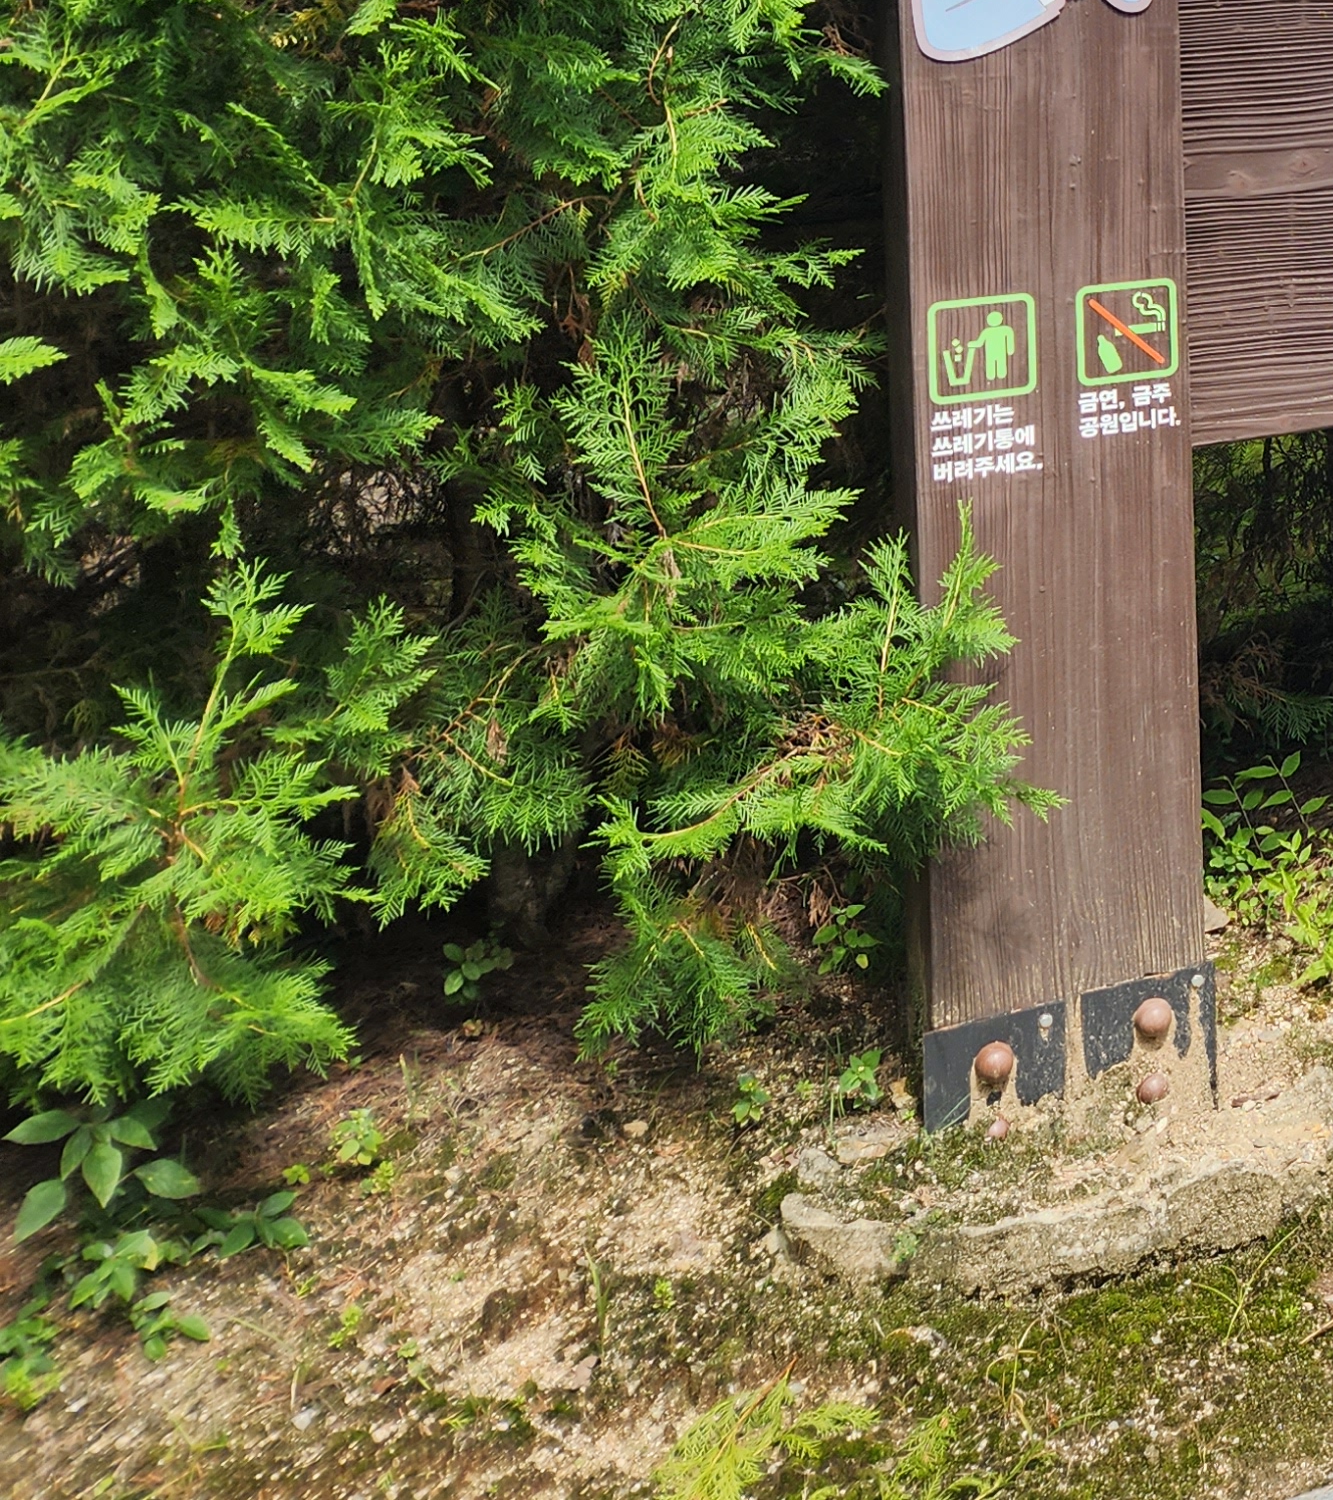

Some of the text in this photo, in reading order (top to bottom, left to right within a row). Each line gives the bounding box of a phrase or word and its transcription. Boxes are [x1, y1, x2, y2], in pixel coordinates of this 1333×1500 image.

[1078, 382, 1172, 414] 금연, 금주
[930, 404, 1015, 432] 쓰레기는
[1078, 406, 1181, 438] 공원입니다.
[931, 425, 1036, 457] 쓰레기통에
[932, 450, 1043, 483] 버려주세요.
